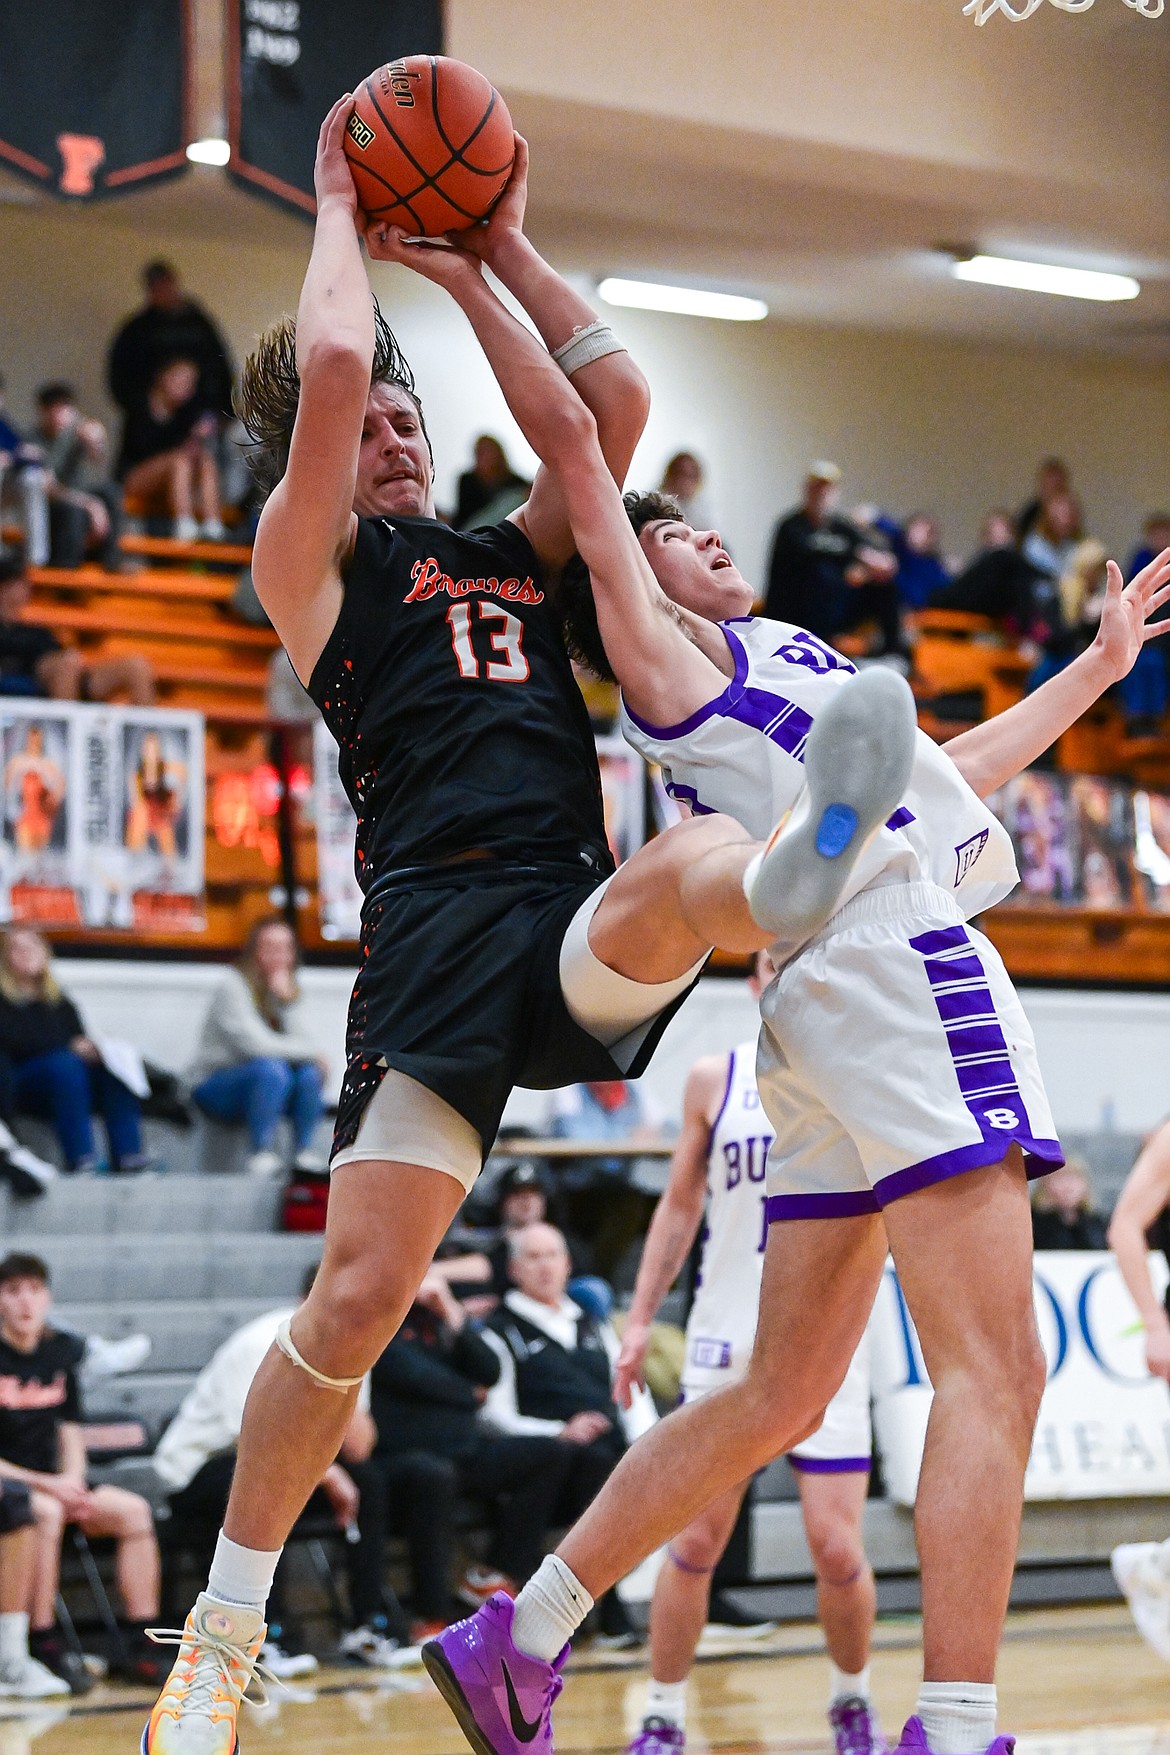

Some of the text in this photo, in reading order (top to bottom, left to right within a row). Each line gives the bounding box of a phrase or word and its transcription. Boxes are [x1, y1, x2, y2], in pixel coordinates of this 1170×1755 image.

[348, 115, 372, 146] PRO
[402, 557, 545, 605] Braves
[445, 600, 531, 683] 13
[983, 1108, 1020, 1130] B
